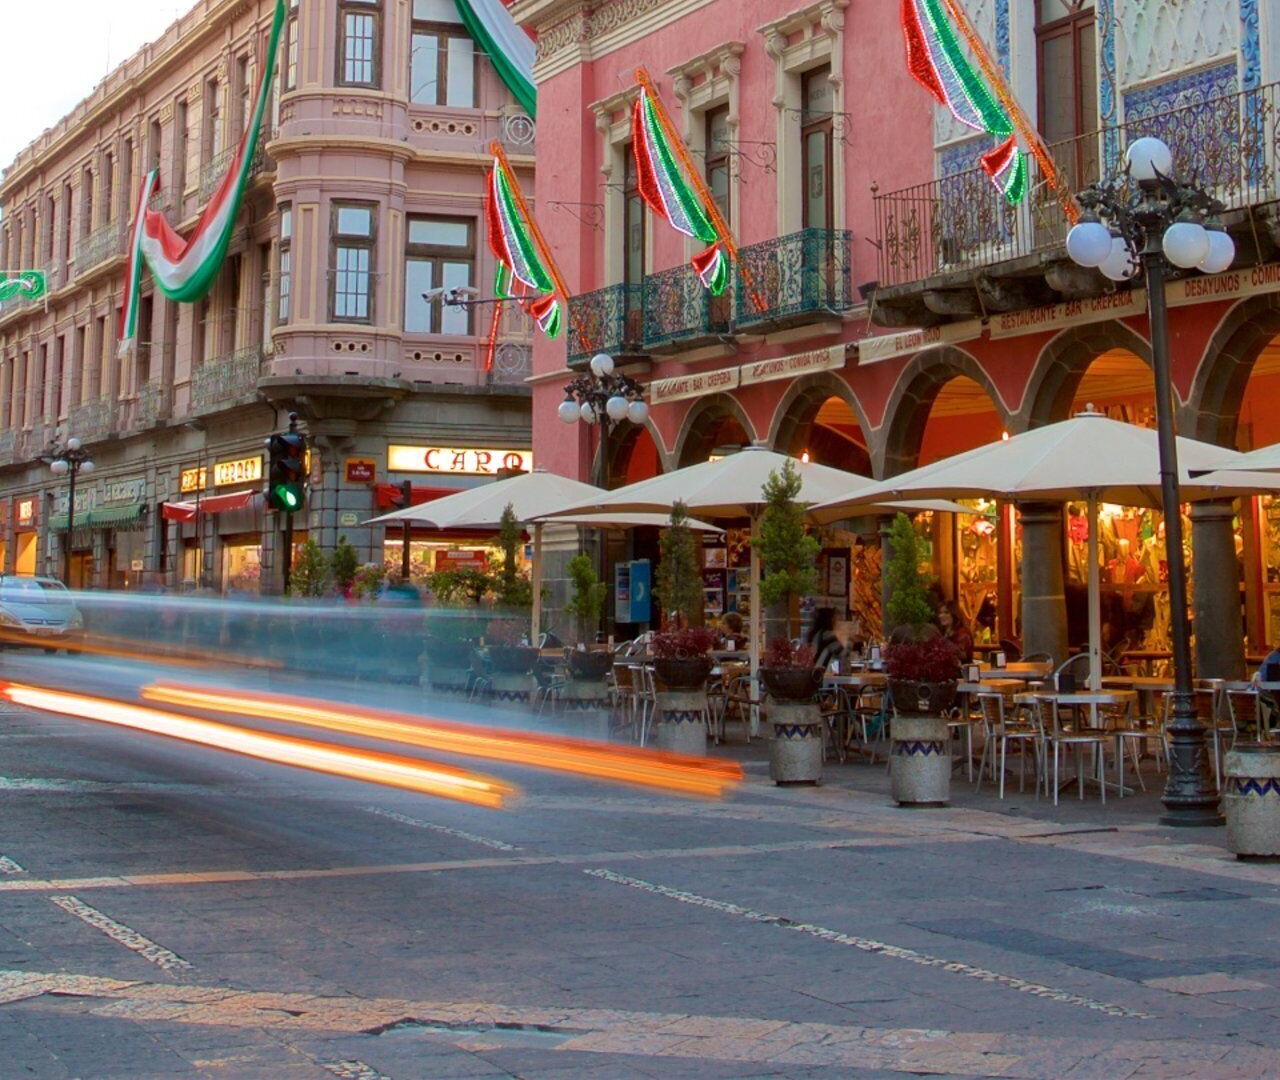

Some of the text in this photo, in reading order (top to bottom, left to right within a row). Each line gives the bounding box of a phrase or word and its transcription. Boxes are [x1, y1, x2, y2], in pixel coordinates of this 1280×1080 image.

[1184, 273, 1240, 298] DESAYUNOS
[1000, 290, 1133, 330] RESTAURANTE BAR CREPERIA
